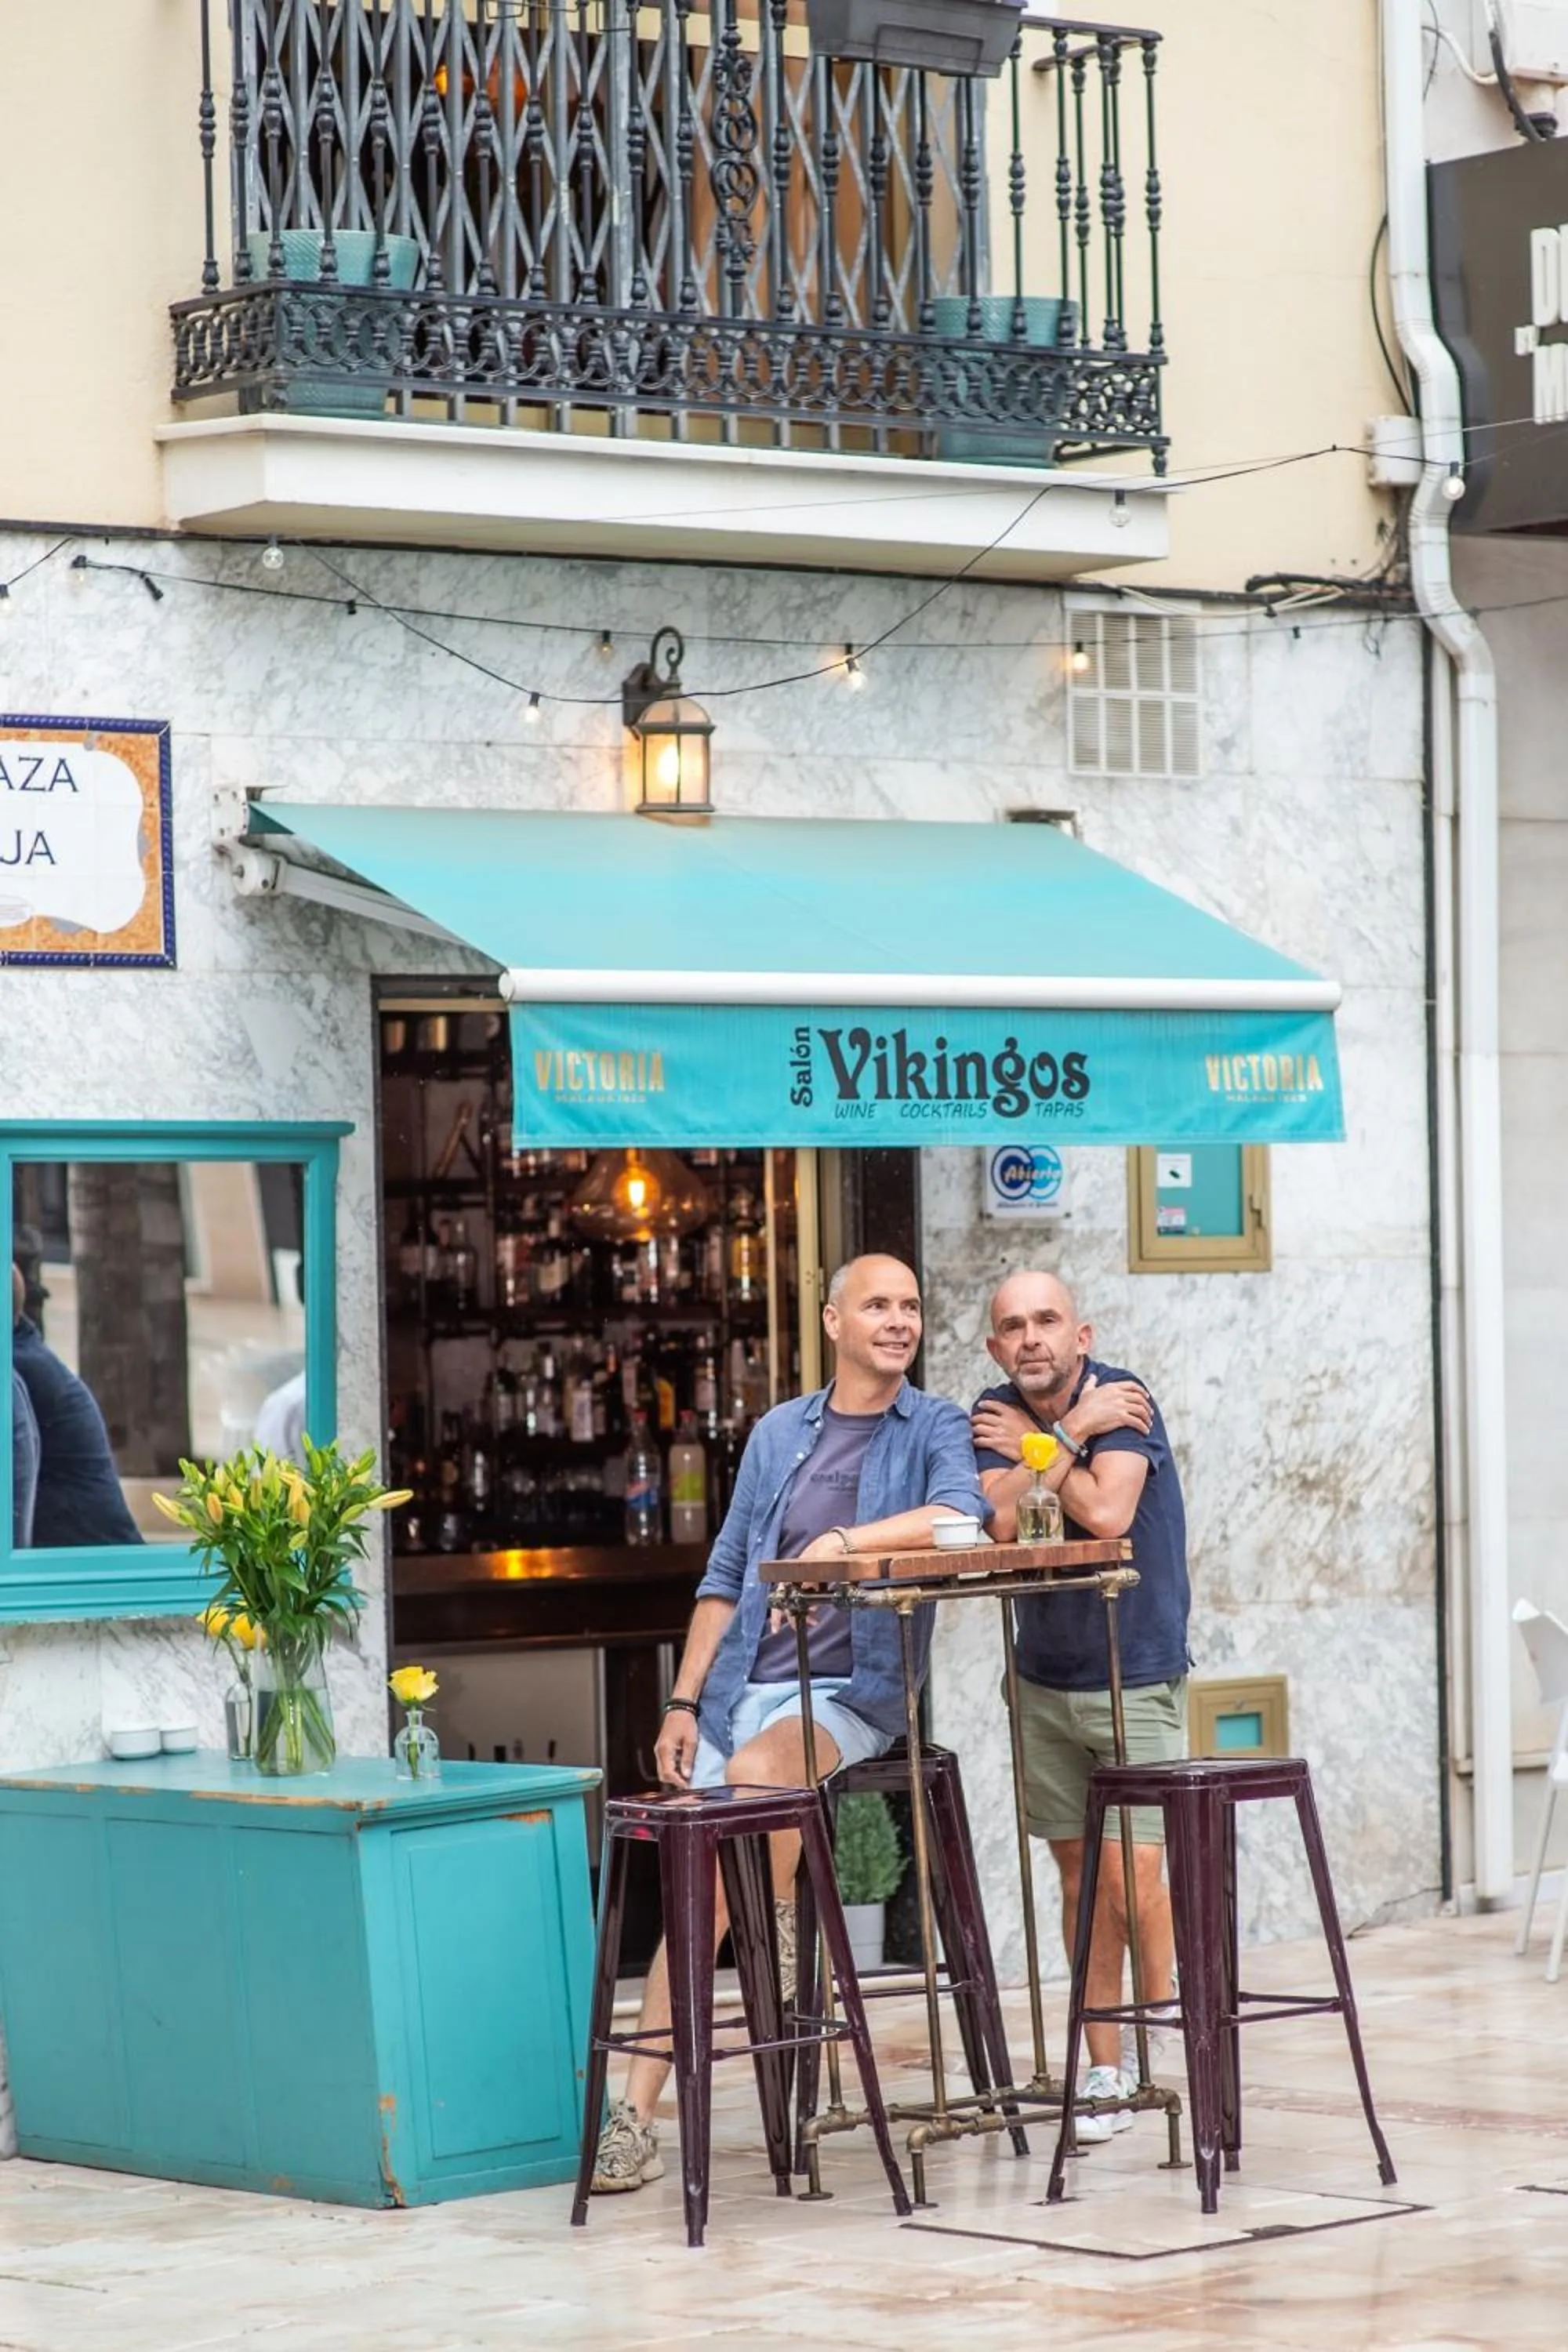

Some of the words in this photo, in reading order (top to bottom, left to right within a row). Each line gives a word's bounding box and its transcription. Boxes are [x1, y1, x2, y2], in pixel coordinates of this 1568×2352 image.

[535, 1051, 666, 1092] VICTORIA
[789, 1026, 813, 1108] Salón
[817, 1026, 1091, 1119] Vikingos
[1205, 1054, 1324, 1093] VICTORIA
[834, 1102, 878, 1120] WINE
[899, 1102, 989, 1120] COCKTAILS
[1033, 1102, 1085, 1120] TAPAS
